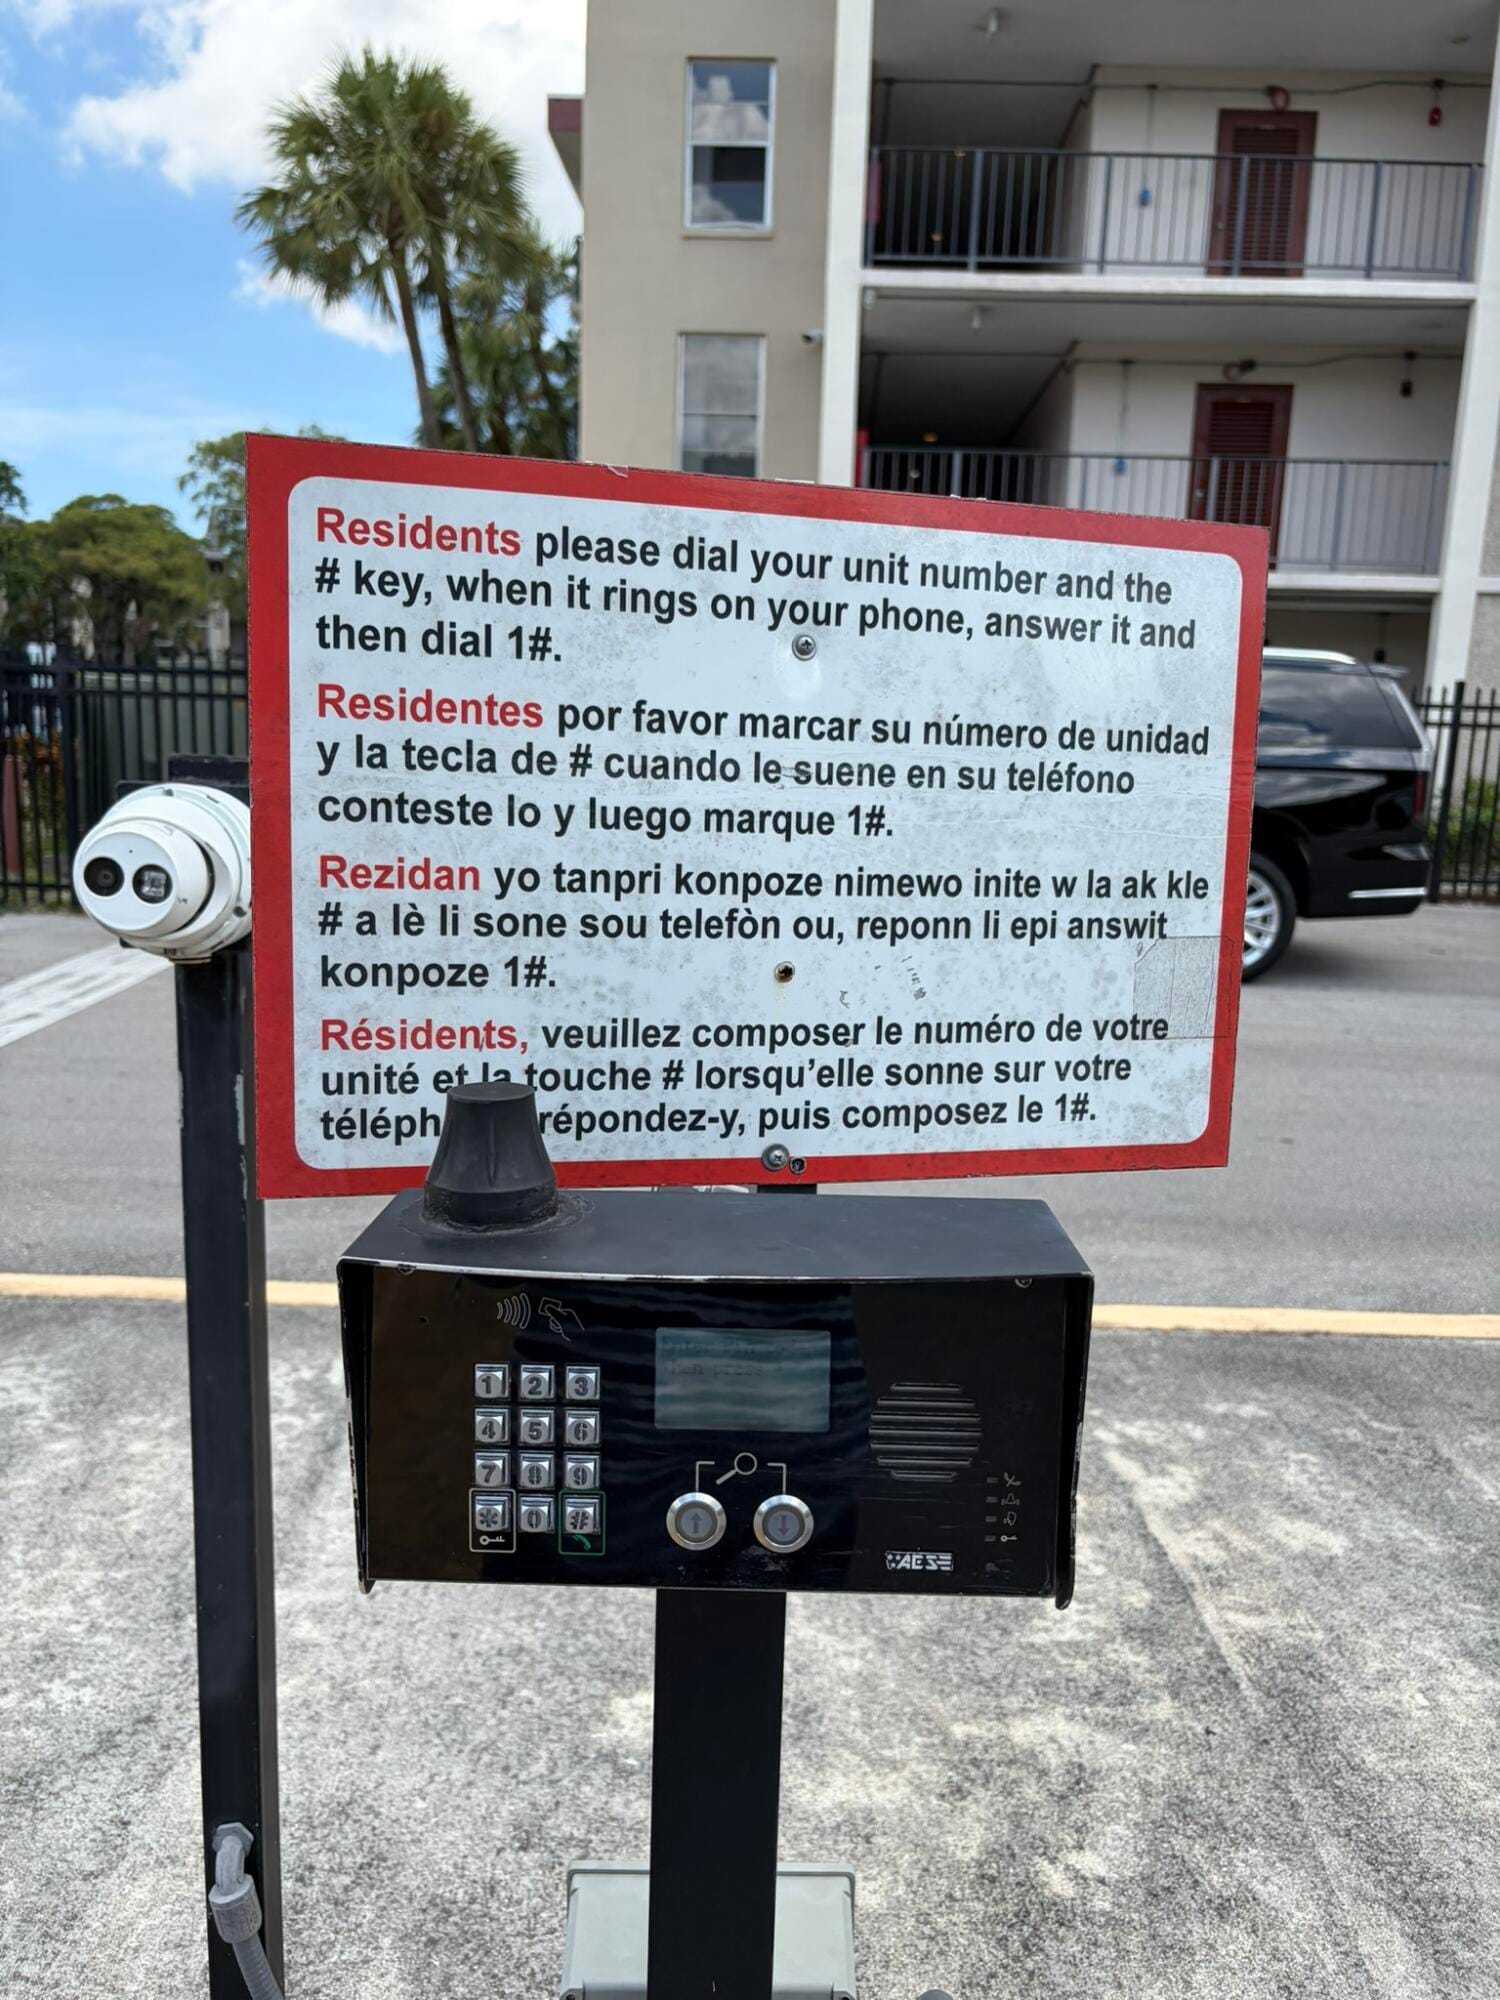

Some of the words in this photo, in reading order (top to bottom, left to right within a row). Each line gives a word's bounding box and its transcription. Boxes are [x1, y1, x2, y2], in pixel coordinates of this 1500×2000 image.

[317, 506, 520, 555] Residents
[536, 525, 659, 566] please
[672, 535, 737, 572] dial
[750, 549, 832, 583] your
[843, 552, 908, 585] unit
[920, 560, 1047, 594] number
[1056, 569, 1113, 599] and
[1124, 572, 1171, 604] the
[314, 556, 340, 593] #
[354, 559, 431, 607] key,
[445, 568, 551, 606] when
[567, 574, 590, 609] it
[603, 578, 697, 624] rings
[710, 593, 754, 620] on
[767, 597, 848, 631] your
[859, 597, 972, 640] phone,
[984, 612, 1102, 641] answer
[1111, 613, 1130, 644] it
[1140, 619, 1195, 648] and
[315, 614, 406, 652] then
[421, 620, 491, 657] dial
[508, 625, 561, 661] 1#.
[318, 683, 542, 727] Residentes
[558, 704, 622, 737] por
[632, 699, 728, 735] favor
[739, 713, 861, 741] marcar
[871, 719, 910, 743] su
[923, 713, 1047, 748] número
[1058, 720, 1095, 750] de
[1106, 723, 1209, 755] unidad
[316, 741, 340, 776] y
[355, 733, 388, 769] la
[401, 737, 496, 773] tecla
[511, 741, 557, 775] de
[569, 743, 592, 777] #
[604, 749, 740, 782] cuando
[753, 751, 781, 783] le
[792, 760, 895, 787] suene
[907, 764, 945, 788] en
[957, 766, 995, 790] su
[1006, 761, 1134, 794] teléfono
[318, 791, 492, 826] conteste
[507, 793, 540, 827] lo
[553, 803, 575, 837] y
[589, 796, 691, 840] luego
[704, 808, 834, 842] marque
[847, 804, 892, 836] 1#.
[320, 855, 479, 890] Rezidan
[493, 867, 540, 900] yo
[552, 861, 660, 901] tanpri
[675, 863, 822, 903] konpoze
[835, 866, 962, 897] nimewo
[974, 867, 1040, 898] inite
[1051, 876, 1077, 897] w
[1086, 868, 1110, 898] la
[1121, 869, 1156, 898] ak
[1167, 869, 1208, 899] kle
[317, 901, 342, 935] #
[355, 910, 377, 936] a
[392, 902, 425, 936] lè
[439, 903, 458, 936] li
[473, 912, 566, 937] sone
[579, 913, 646, 938] sou
[659, 907, 779, 939] telefòn
[792, 916, 843, 945] ou,
[856, 916, 970, 946] reponn
[983, 909, 999, 939] li
[1010, 909, 1057, 946] epi
[1067, 910, 1167, 939] answit
[320, 954, 489, 995] konpoze
[504, 955, 556, 988] 1#.
[321, 1017, 527, 1054] Résidents,
[541, 1017, 680, 1048] veuillez
[692, 1022, 865, 1054] composer
[875, 1015, 902, 1045] le
[914, 1013, 1034, 1044] numéro
[1045, 1013, 1082, 1041] de
[1092, 1012, 1168, 1040] votre
[321, 1061, 419, 1096] unité
[432, 1063, 468, 1093] et
[524, 1060, 651, 1091] touche
[662, 1059, 684, 1090] #
[884, 1061, 983, 1086] sonne
[993, 1060, 1045, 1083] sur
[1054, 1053, 1131, 1081] votre
[319, 1106, 440, 1140] téléph
[538, 1101, 745, 1140] répondez-y,
[758, 1100, 830, 1137] puis
[842, 1102, 1007, 1133] composez
[1018, 1094, 1042, 1122] le
[1055, 1092, 1095, 1121] 1#.
